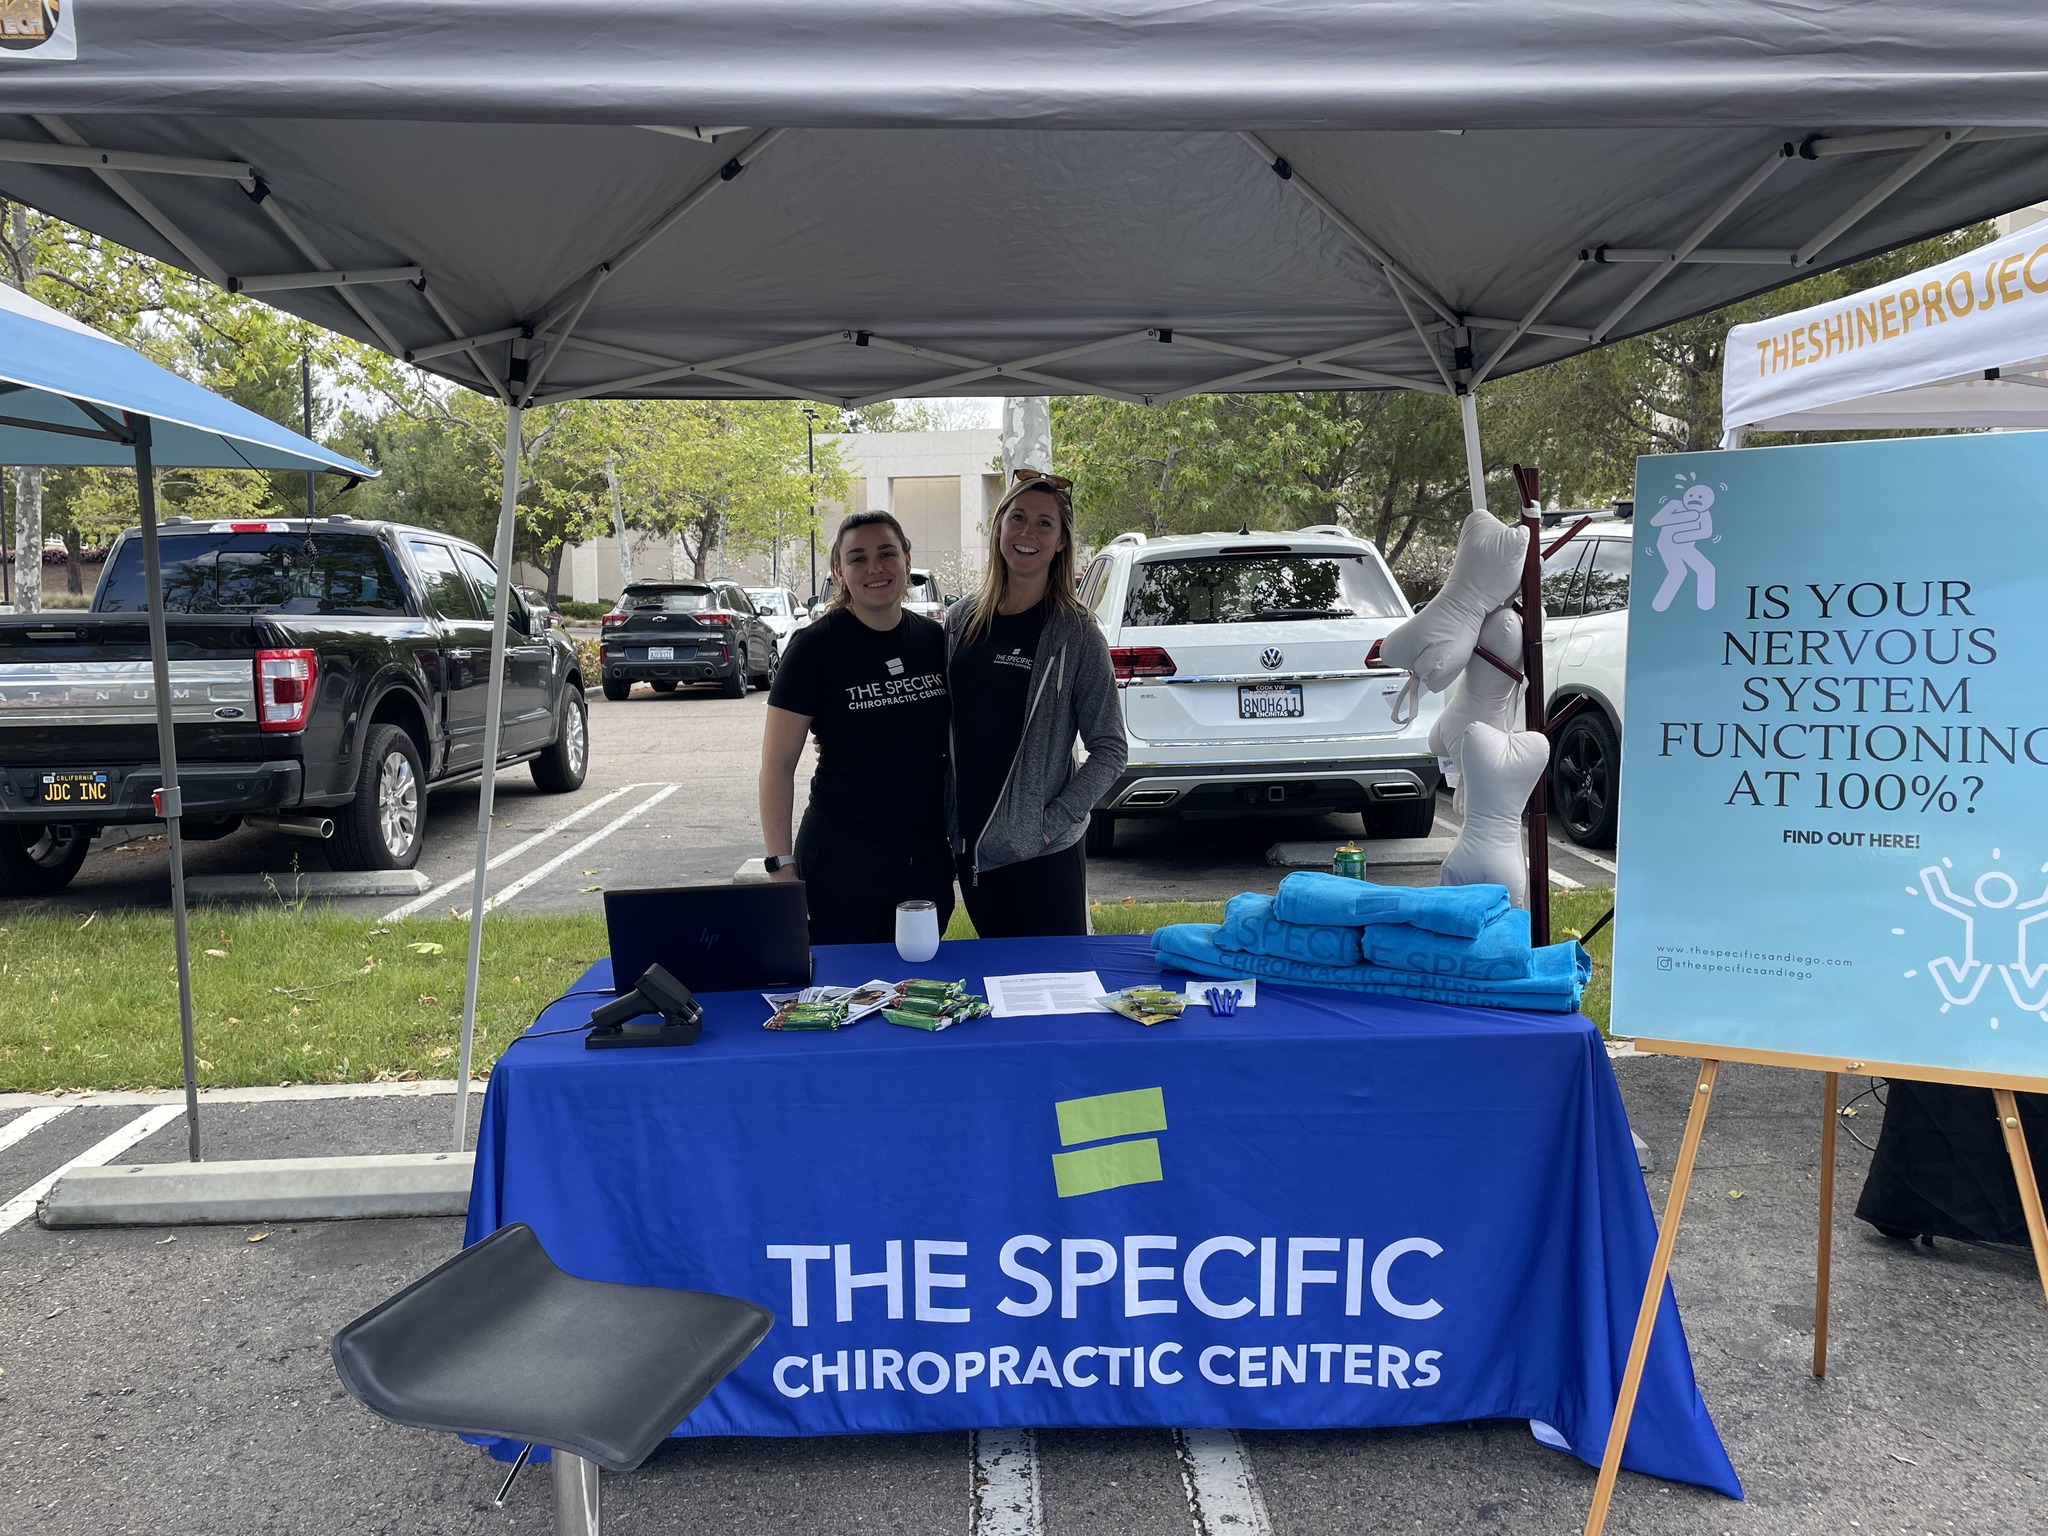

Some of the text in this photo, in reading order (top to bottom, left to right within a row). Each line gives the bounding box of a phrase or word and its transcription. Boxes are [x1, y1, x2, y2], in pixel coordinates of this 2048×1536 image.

[1746, 580, 1975, 620] IS YOUR
[1721, 628, 1998, 666] NERVOUS
[995, 653, 1034, 666] THE SPECIFIC
[845, 683, 883, 700] THE
[848, 694, 918, 710] CHIROPRACTIC
[1742, 677, 1973, 714] SYSTEM
[1256, 710, 1288, 718] ENCINITAS
[56, 774, 94, 782] CALIFORNIA
[44, 783, 107, 801] JDC INC
[1724, 770, 1984, 813] AT 100%?
[1783, 829, 1920, 850] FIND OUT HERE!
[1656, 945, 1853, 967] www.thespecificsandiego.com
[1675, 960, 1812, 980] @thespecificsandiego
[766, 1234, 1445, 1327] THE SPECIFIC
[773, 1341, 1443, 1399] CHIROPRACTIC CENTERS
